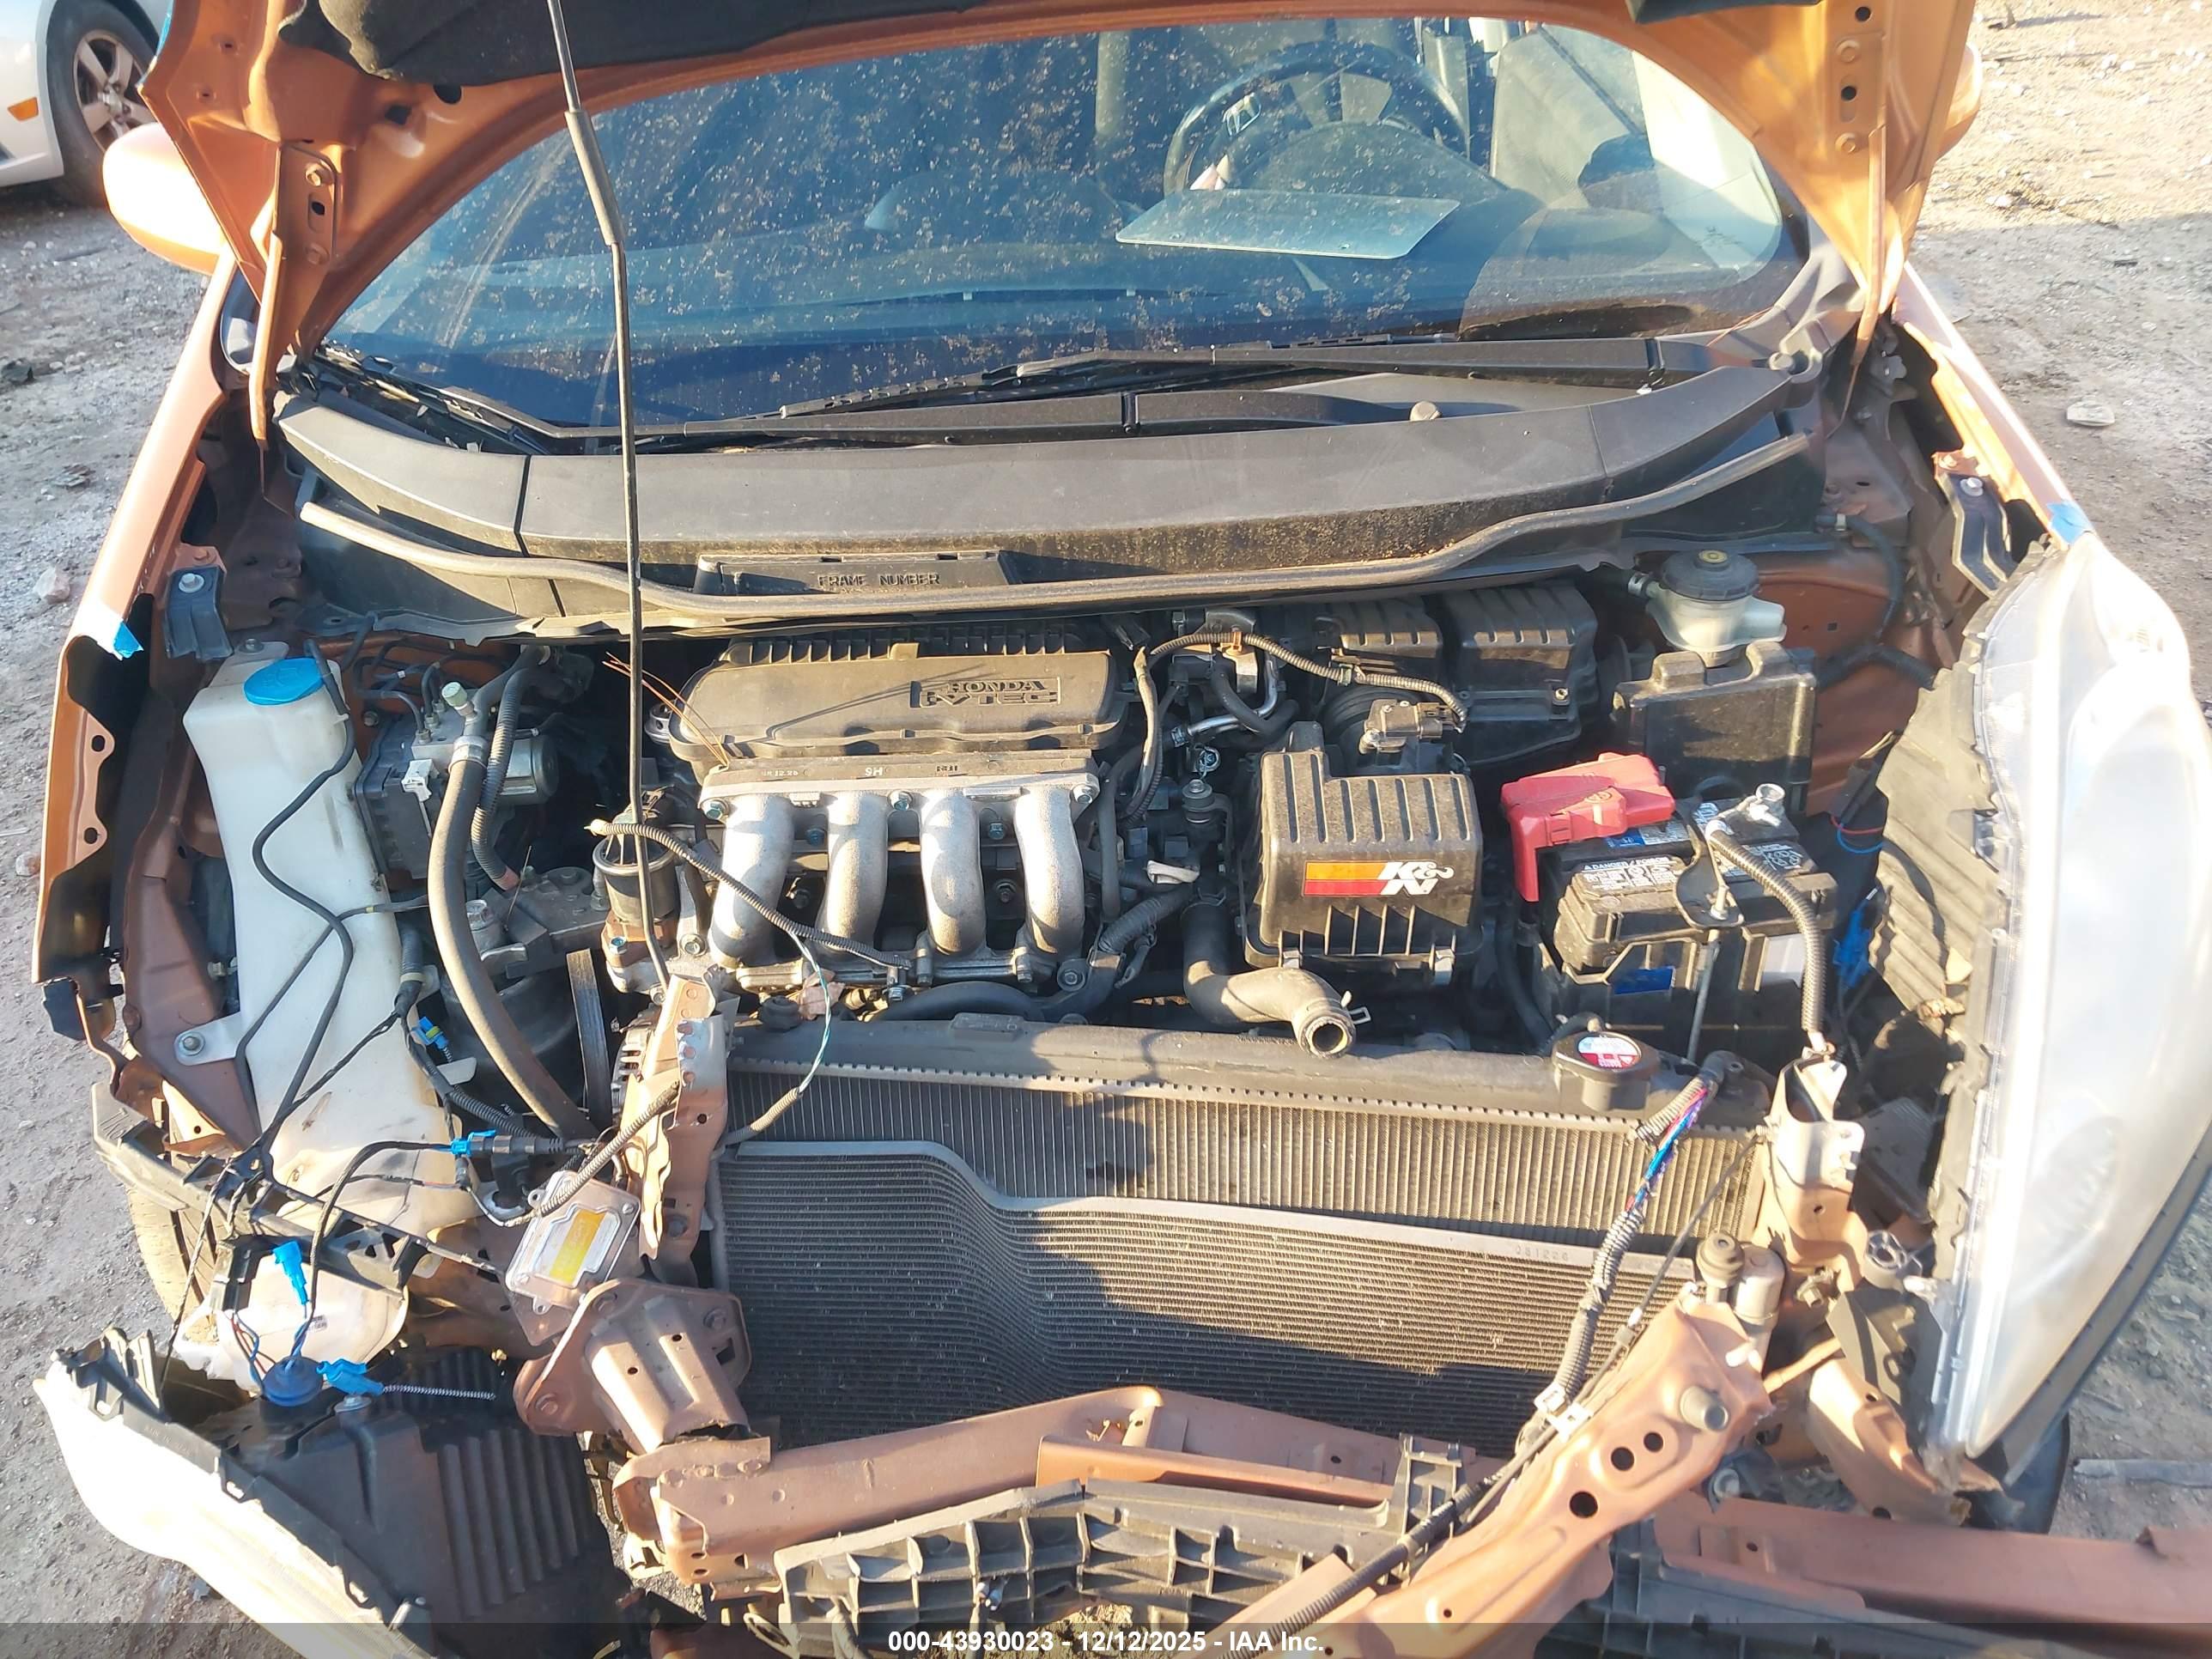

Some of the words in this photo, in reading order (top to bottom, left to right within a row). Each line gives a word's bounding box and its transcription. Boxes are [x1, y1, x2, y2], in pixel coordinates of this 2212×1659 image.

[818, 575, 866, 586] FRAME
[879, 574, 940, 586] NUMBER
[947, 681, 1045, 693] HONDA
